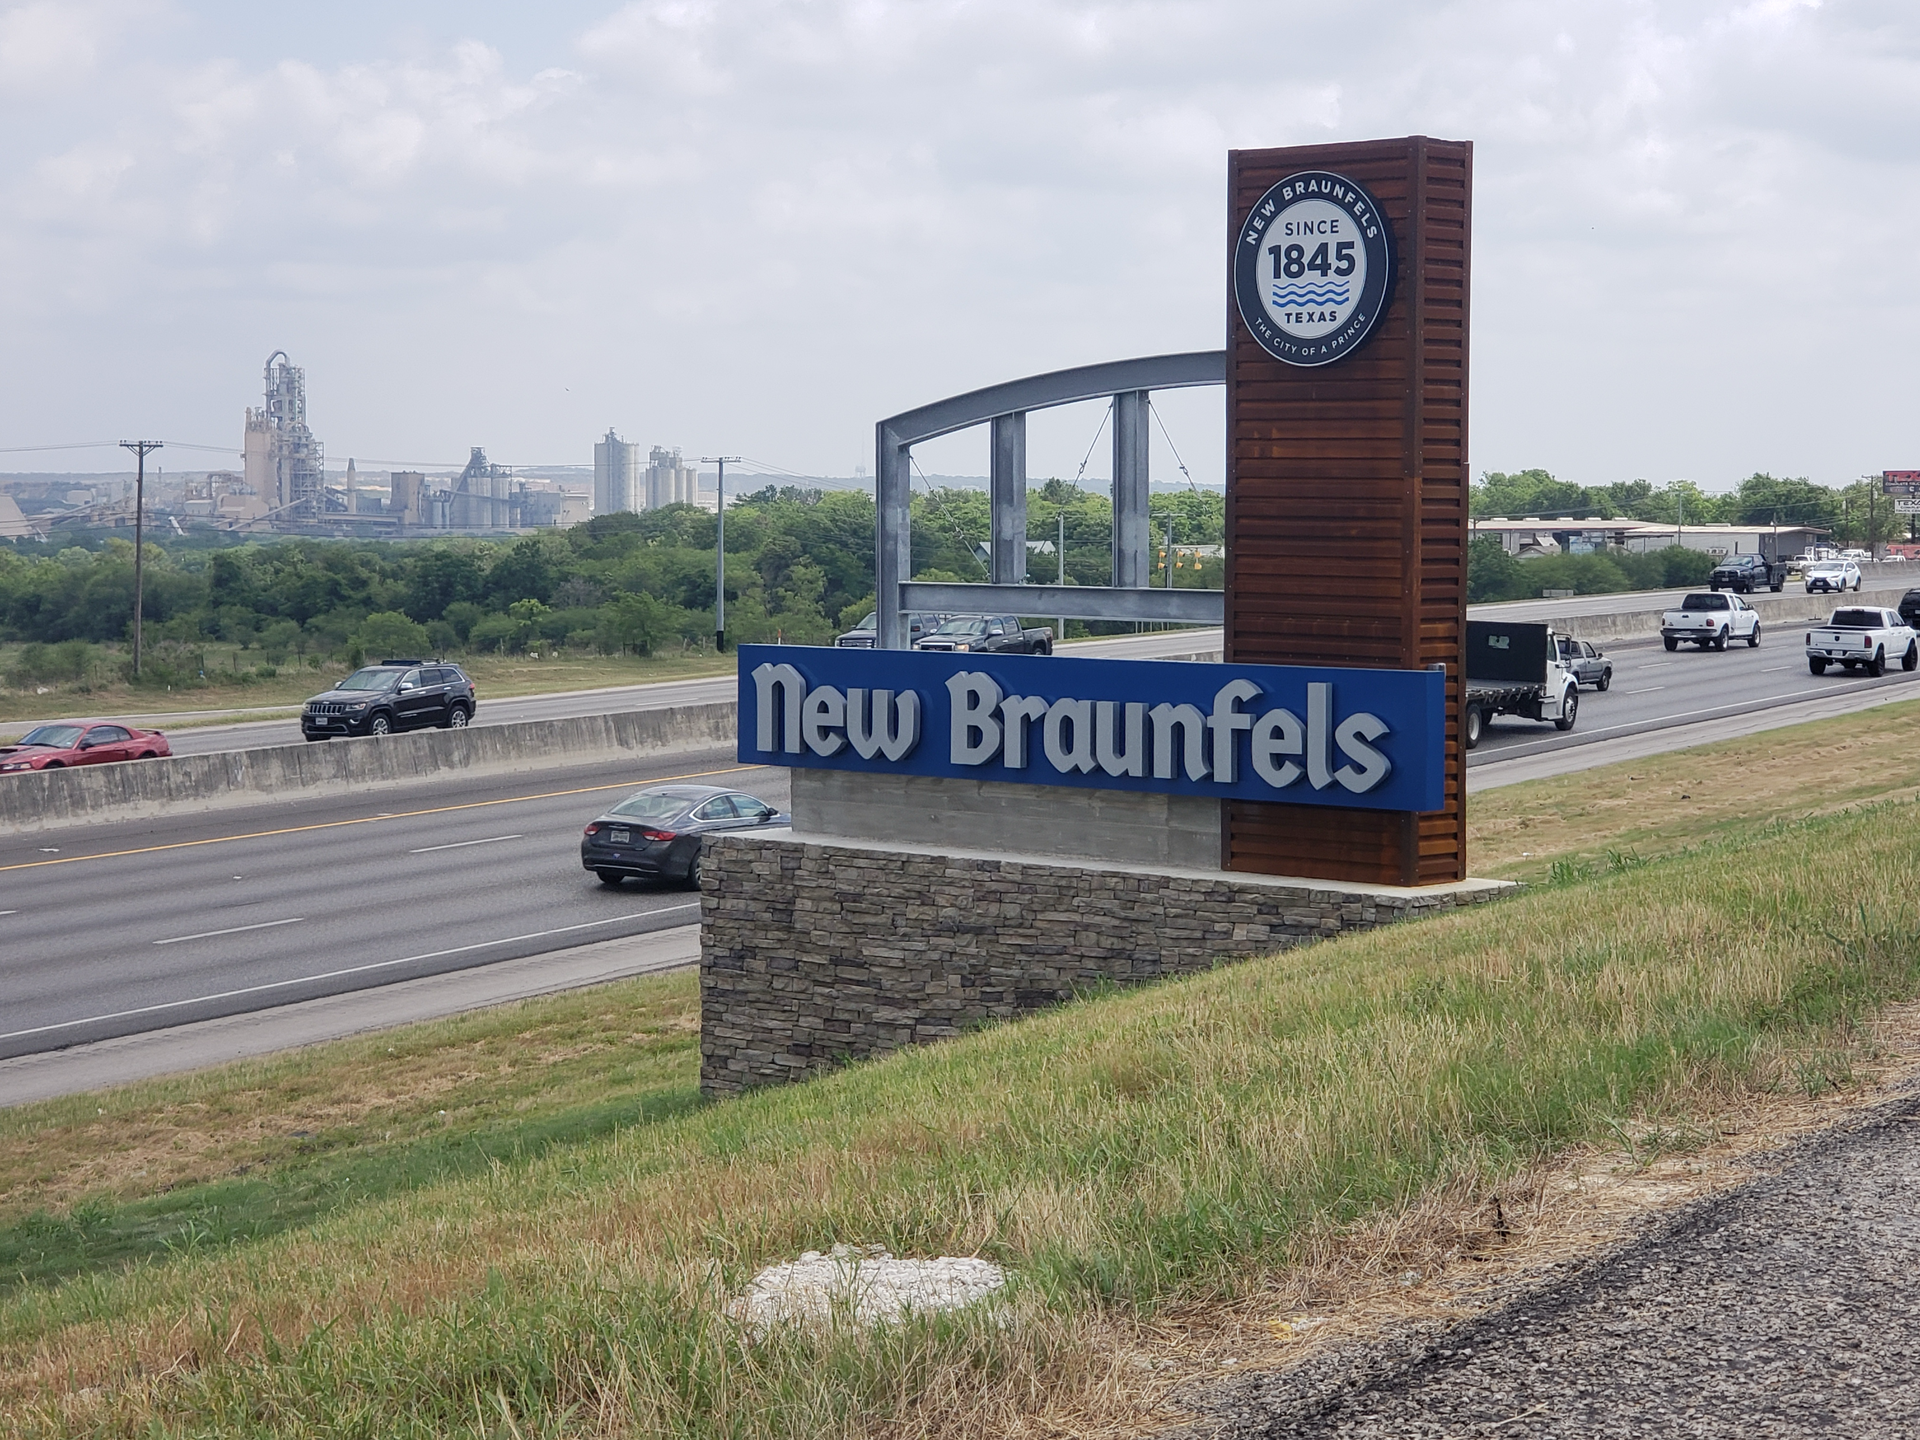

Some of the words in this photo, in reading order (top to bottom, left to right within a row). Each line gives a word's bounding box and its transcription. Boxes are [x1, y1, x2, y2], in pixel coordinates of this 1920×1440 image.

[1246, 199, 1276, 245] NEW
[1282, 179, 1378, 239] BRAUNFELS
[1284, 219, 1340, 236] SINCE
[1267, 241, 1355, 280] 1845
[1255, 317, 1272, 338] THE
[1273, 338, 1298, 355] CITY
[1301, 347, 1315, 356] OF
[1320, 344, 1328, 354] A
[1331, 312, 1366, 350] PRINCE
[1284, 310, 1338, 324] TEXAS
[752, 661, 921, 763] New
[945, 669, 1392, 794] Braunfels
